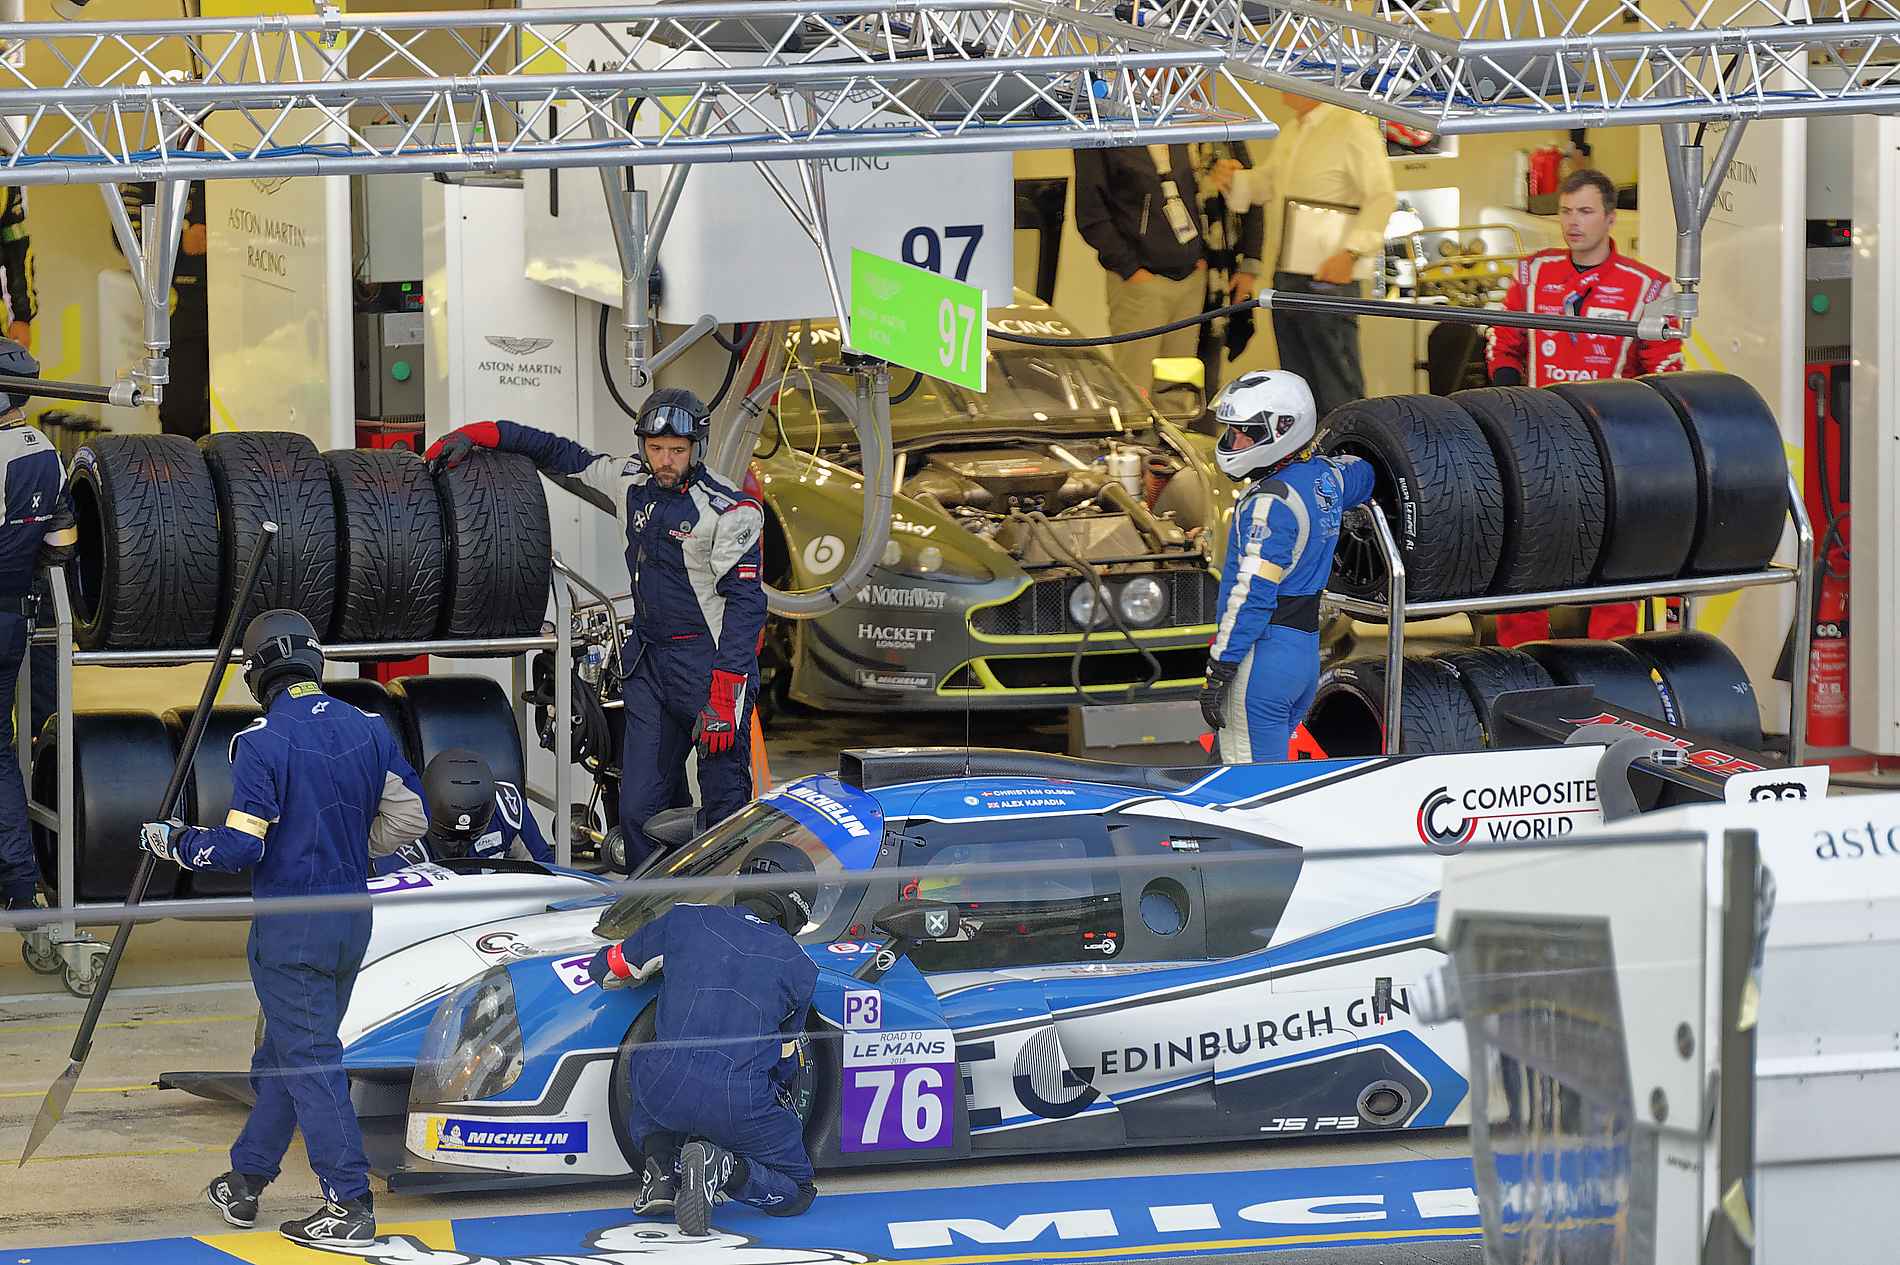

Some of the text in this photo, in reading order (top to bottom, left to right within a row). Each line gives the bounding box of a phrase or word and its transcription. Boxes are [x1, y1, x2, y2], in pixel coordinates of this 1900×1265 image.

[228, 207, 306, 248] ASTON MARTIN
[247, 245, 287, 276] RACING
[902, 224, 985, 282] 97
[938, 297, 976, 373] 97
[987, 319, 1072, 336] ACING
[478, 361, 562, 375] ASTON MARTIN
[499, 375, 541, 387] RACING
[858, 623, 936, 642] HACKETT
[876, 640, 916, 649] LONDON
[993, 789, 1044, 797] CHRISTIAN
[1463, 779, 1597, 811] COMPOSITE
[788, 786, 871, 838] MICHELIN
[1001, 798, 1067, 809] ALEX KAPADIA
[1488, 816, 1573, 843] WORLD
[846, 995, 879, 1025] P3
[880, 1031, 923, 1042] ROAD TO
[1101, 987, 1411, 1075] EDINBURGH GIN
[853, 1041, 945, 1058] LE MANS
[855, 1067, 943, 1144] 76
[1260, 1116, 1360, 1131] JS P3
[467, 1132, 569, 1145] MICHELIN
